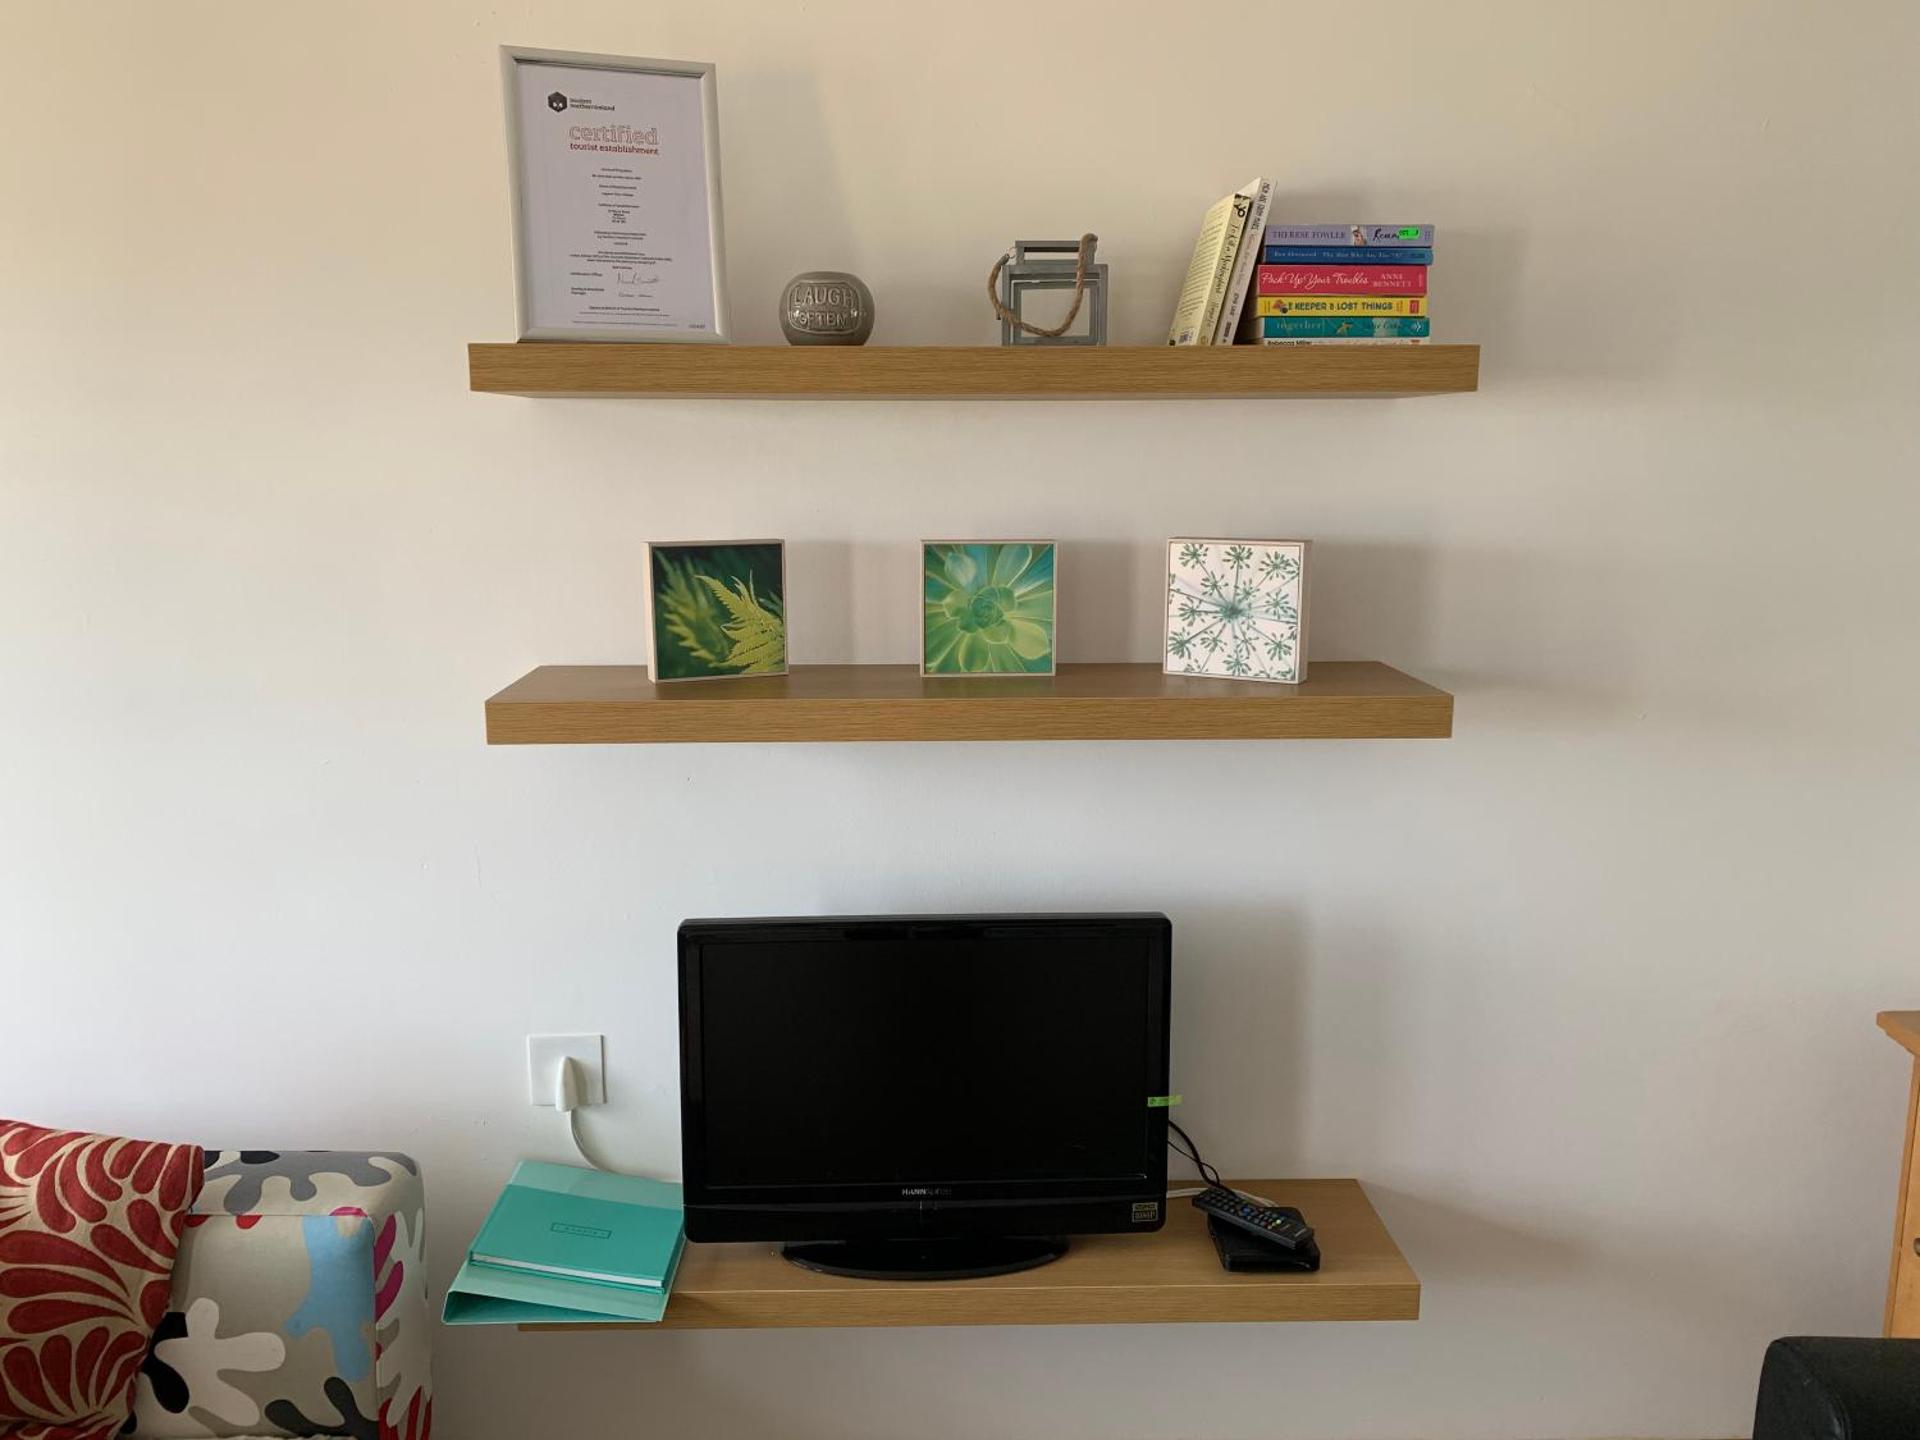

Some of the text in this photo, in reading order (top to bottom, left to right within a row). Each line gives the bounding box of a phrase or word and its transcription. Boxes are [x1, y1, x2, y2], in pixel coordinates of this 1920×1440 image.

[569, 124, 659, 145] certified
[570, 143, 659, 155] tourist establishment
[1272, 230, 1346, 239] THERESE FOWLER
[1261, 272, 1369, 290] Pack Up Your Troubles
[794, 285, 855, 308] LAUGH
[1294, 302, 1327, 310] KEEPER
[1337, 302, 1358, 310] LOST
[1361, 302, 1393, 311] THINGS
[799, 310, 848, 329] OFTEN
